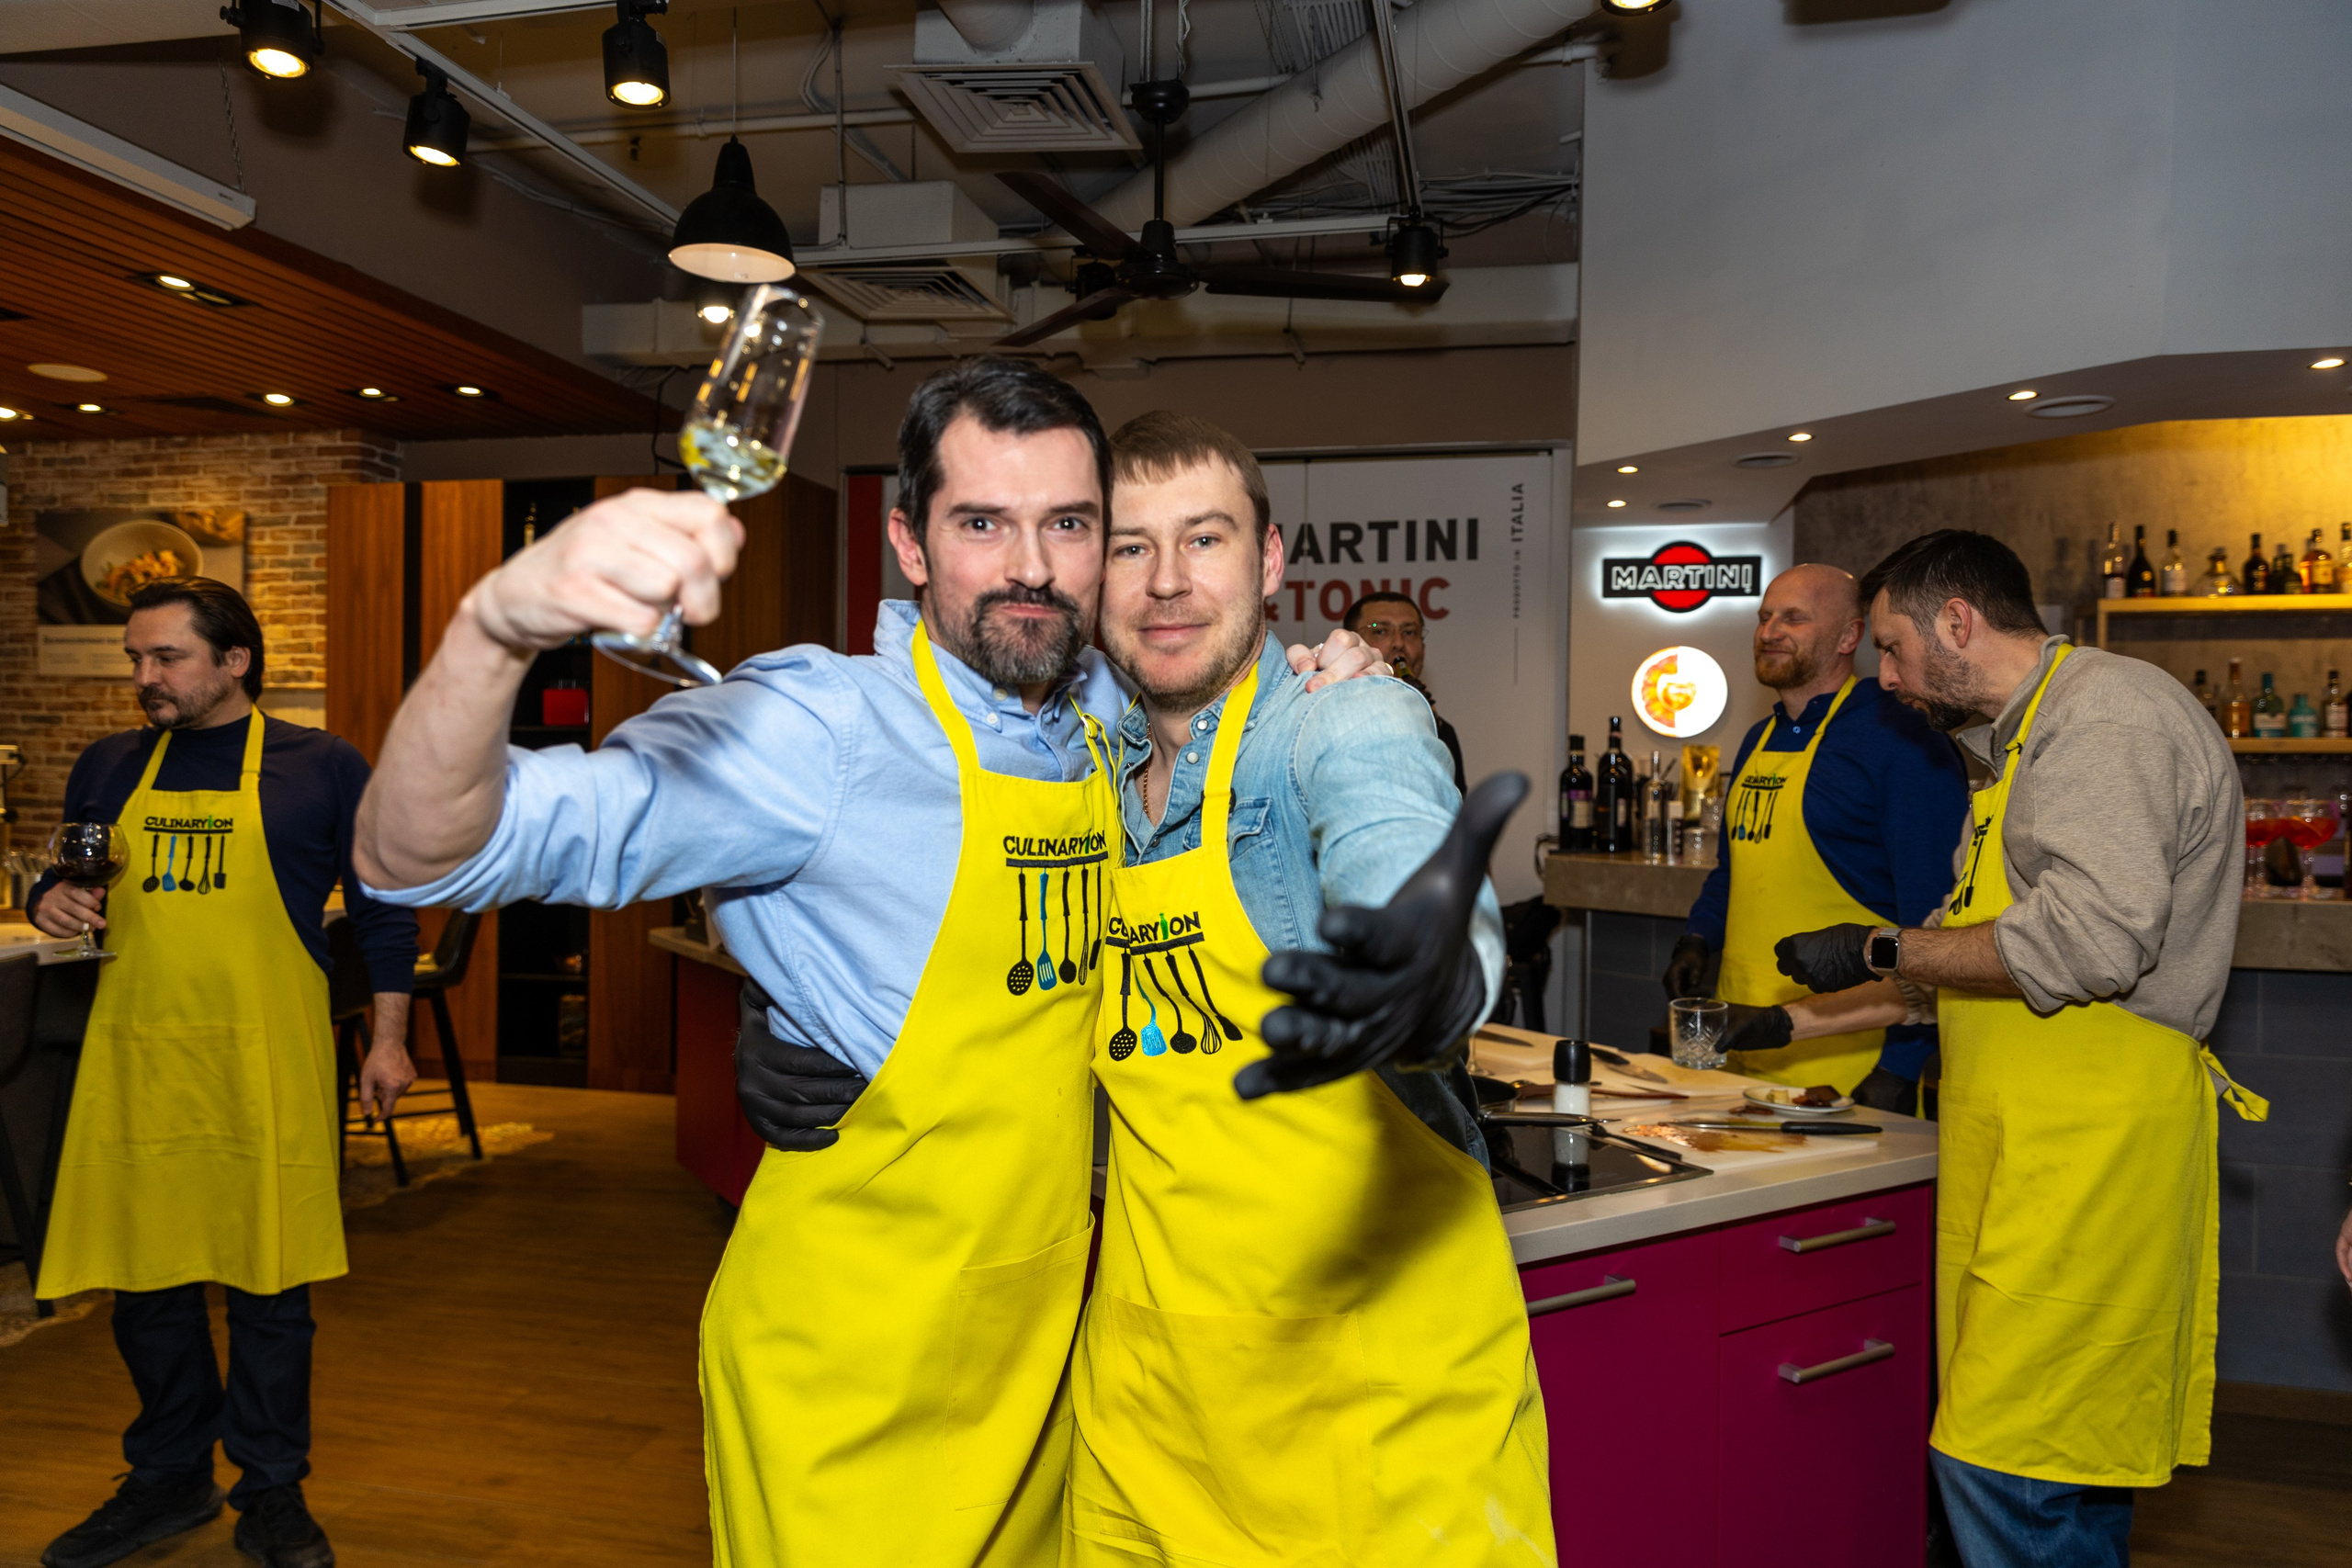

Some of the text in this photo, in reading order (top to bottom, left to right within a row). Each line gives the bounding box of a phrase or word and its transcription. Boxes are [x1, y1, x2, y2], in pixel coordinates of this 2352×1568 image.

[1510, 482, 1524, 542] ITALIA
[1278, 518, 1478, 565] ARTINI
[1611, 563, 1753, 591] MARTINI
